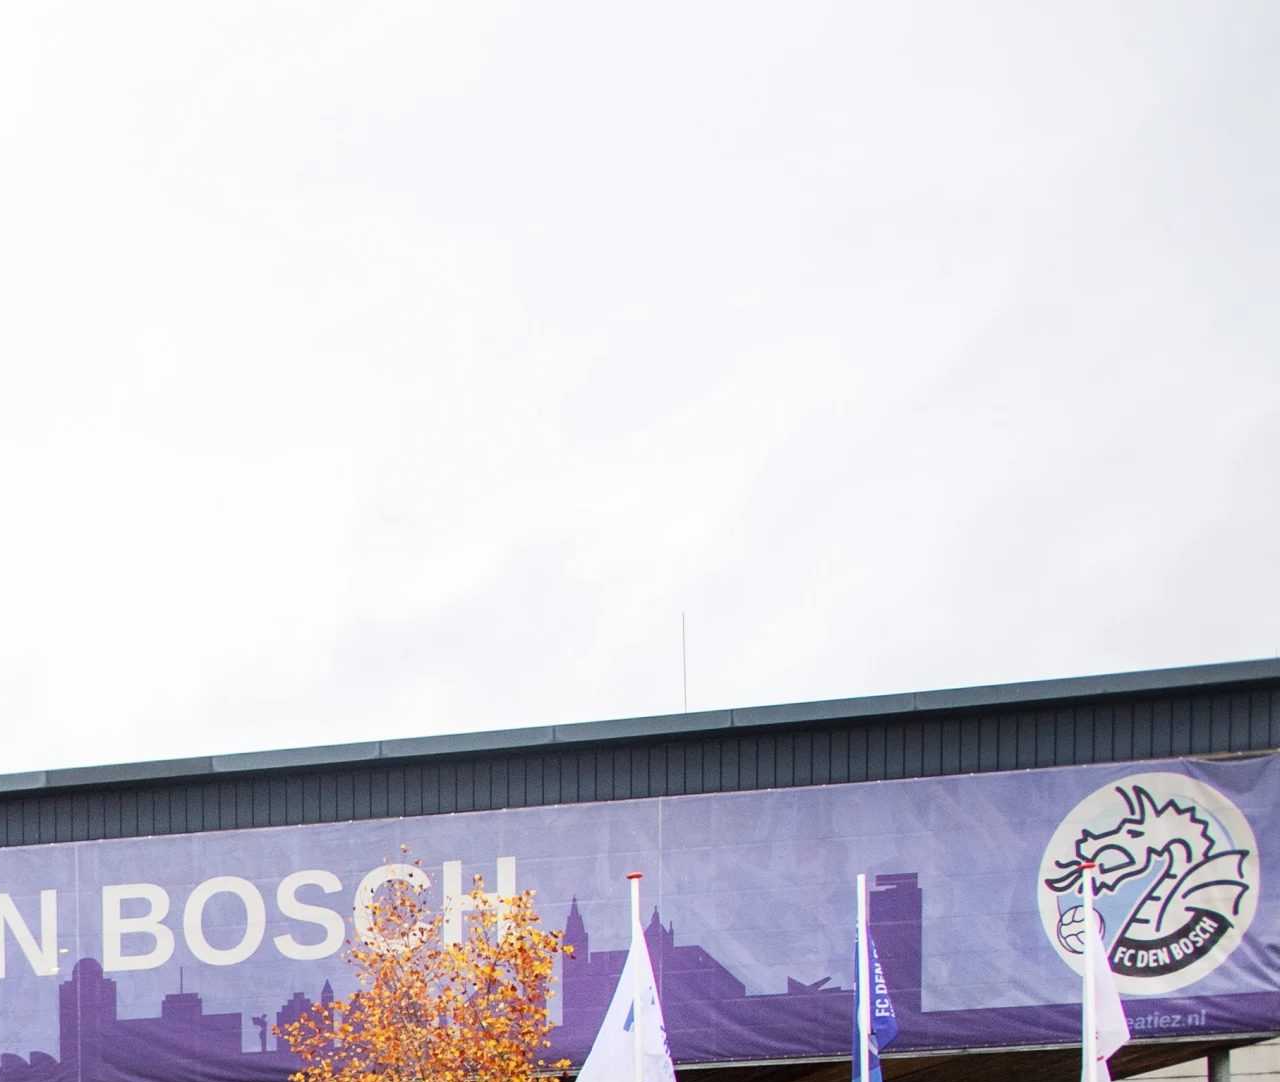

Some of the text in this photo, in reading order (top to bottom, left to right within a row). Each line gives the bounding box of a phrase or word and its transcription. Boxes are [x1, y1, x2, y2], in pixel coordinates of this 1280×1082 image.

[102, 856, 517, 973] BOSCH
[1113, 916, 1219, 968] FC DEN BOSCH
